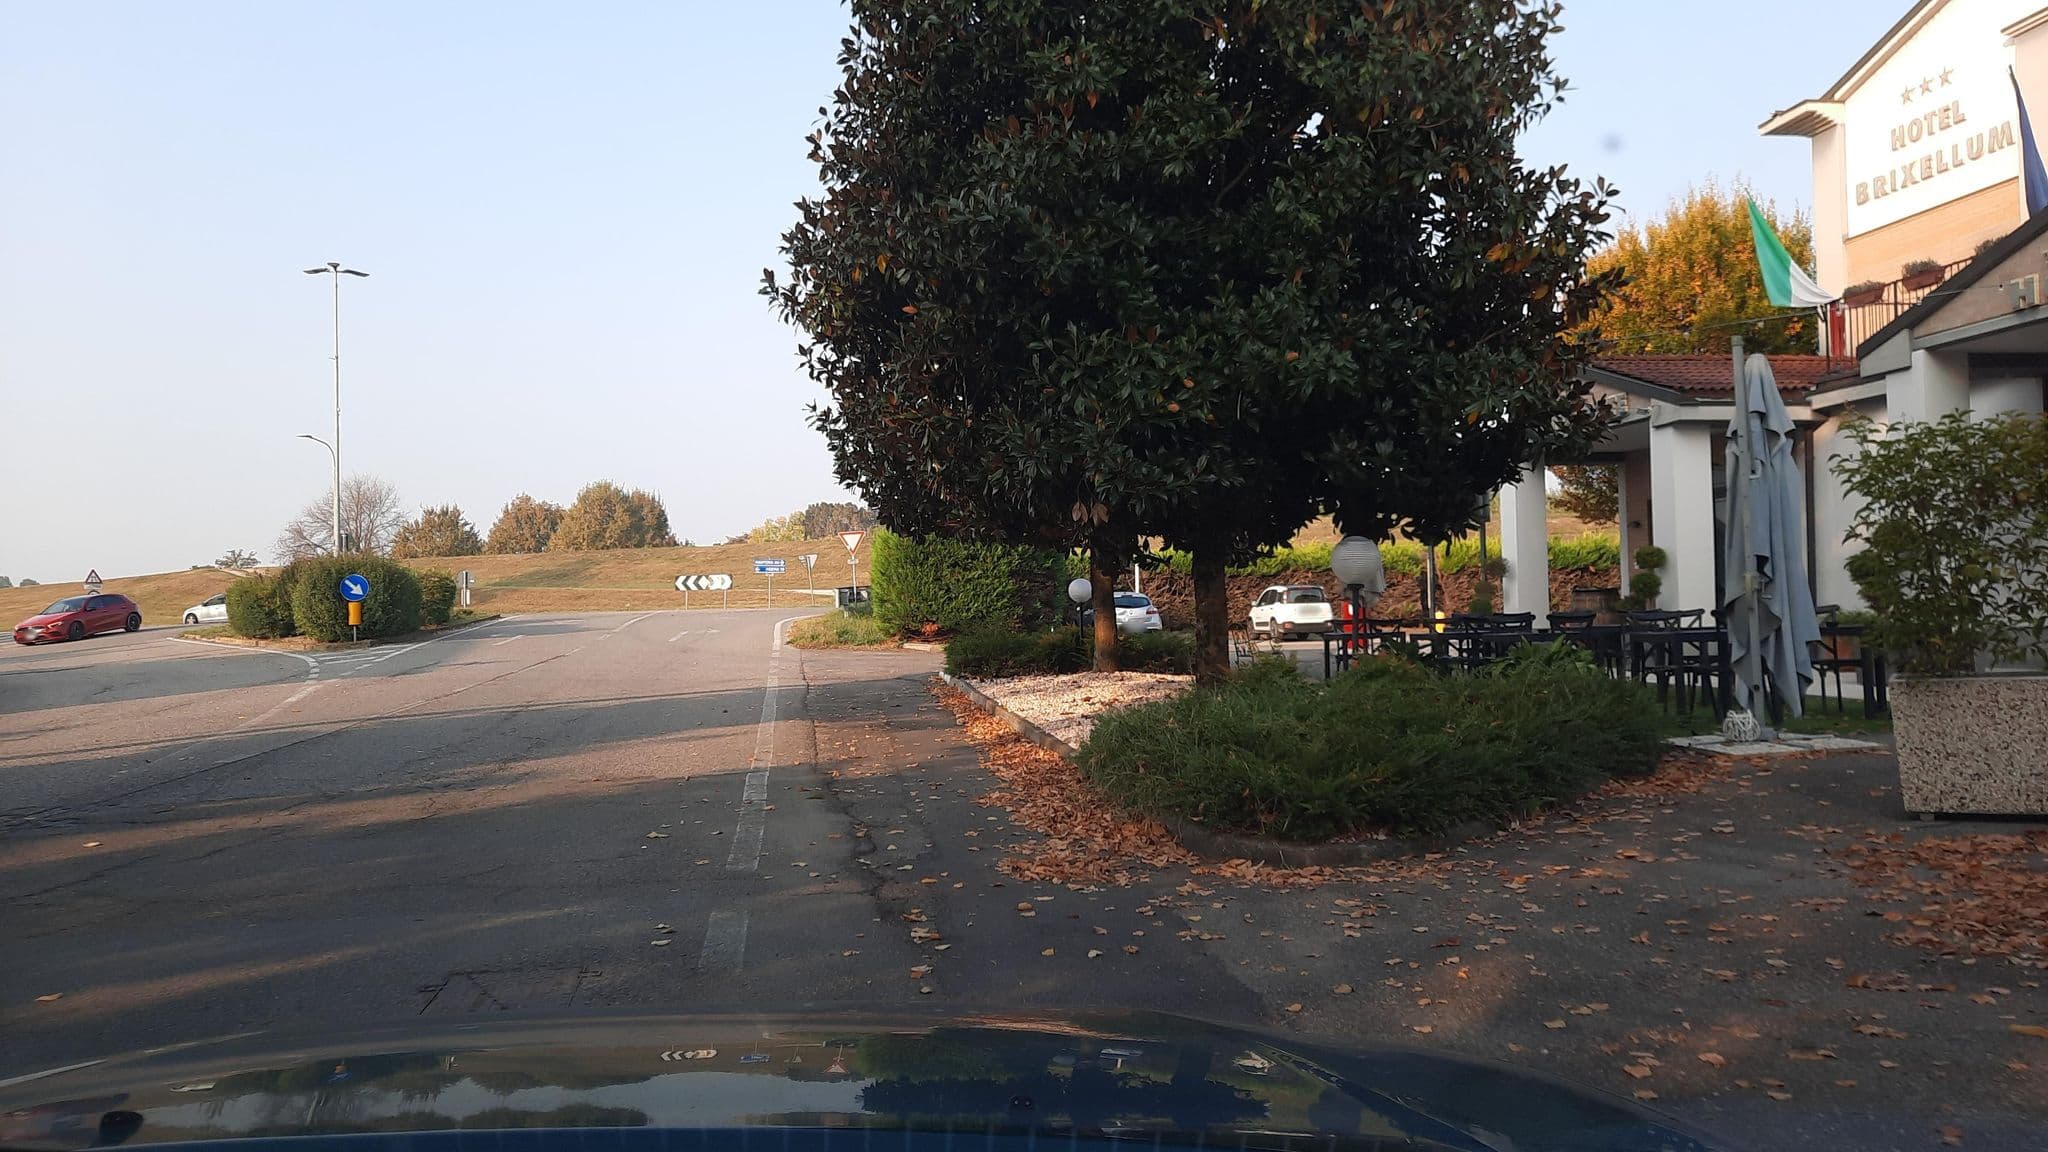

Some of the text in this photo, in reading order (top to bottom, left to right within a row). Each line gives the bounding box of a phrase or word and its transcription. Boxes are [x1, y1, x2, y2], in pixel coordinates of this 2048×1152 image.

[1891, 99, 1967, 152] HOTEL
[1856, 120, 2017, 206] BRIXELLUM
[2009, 271, 2048, 311] H
